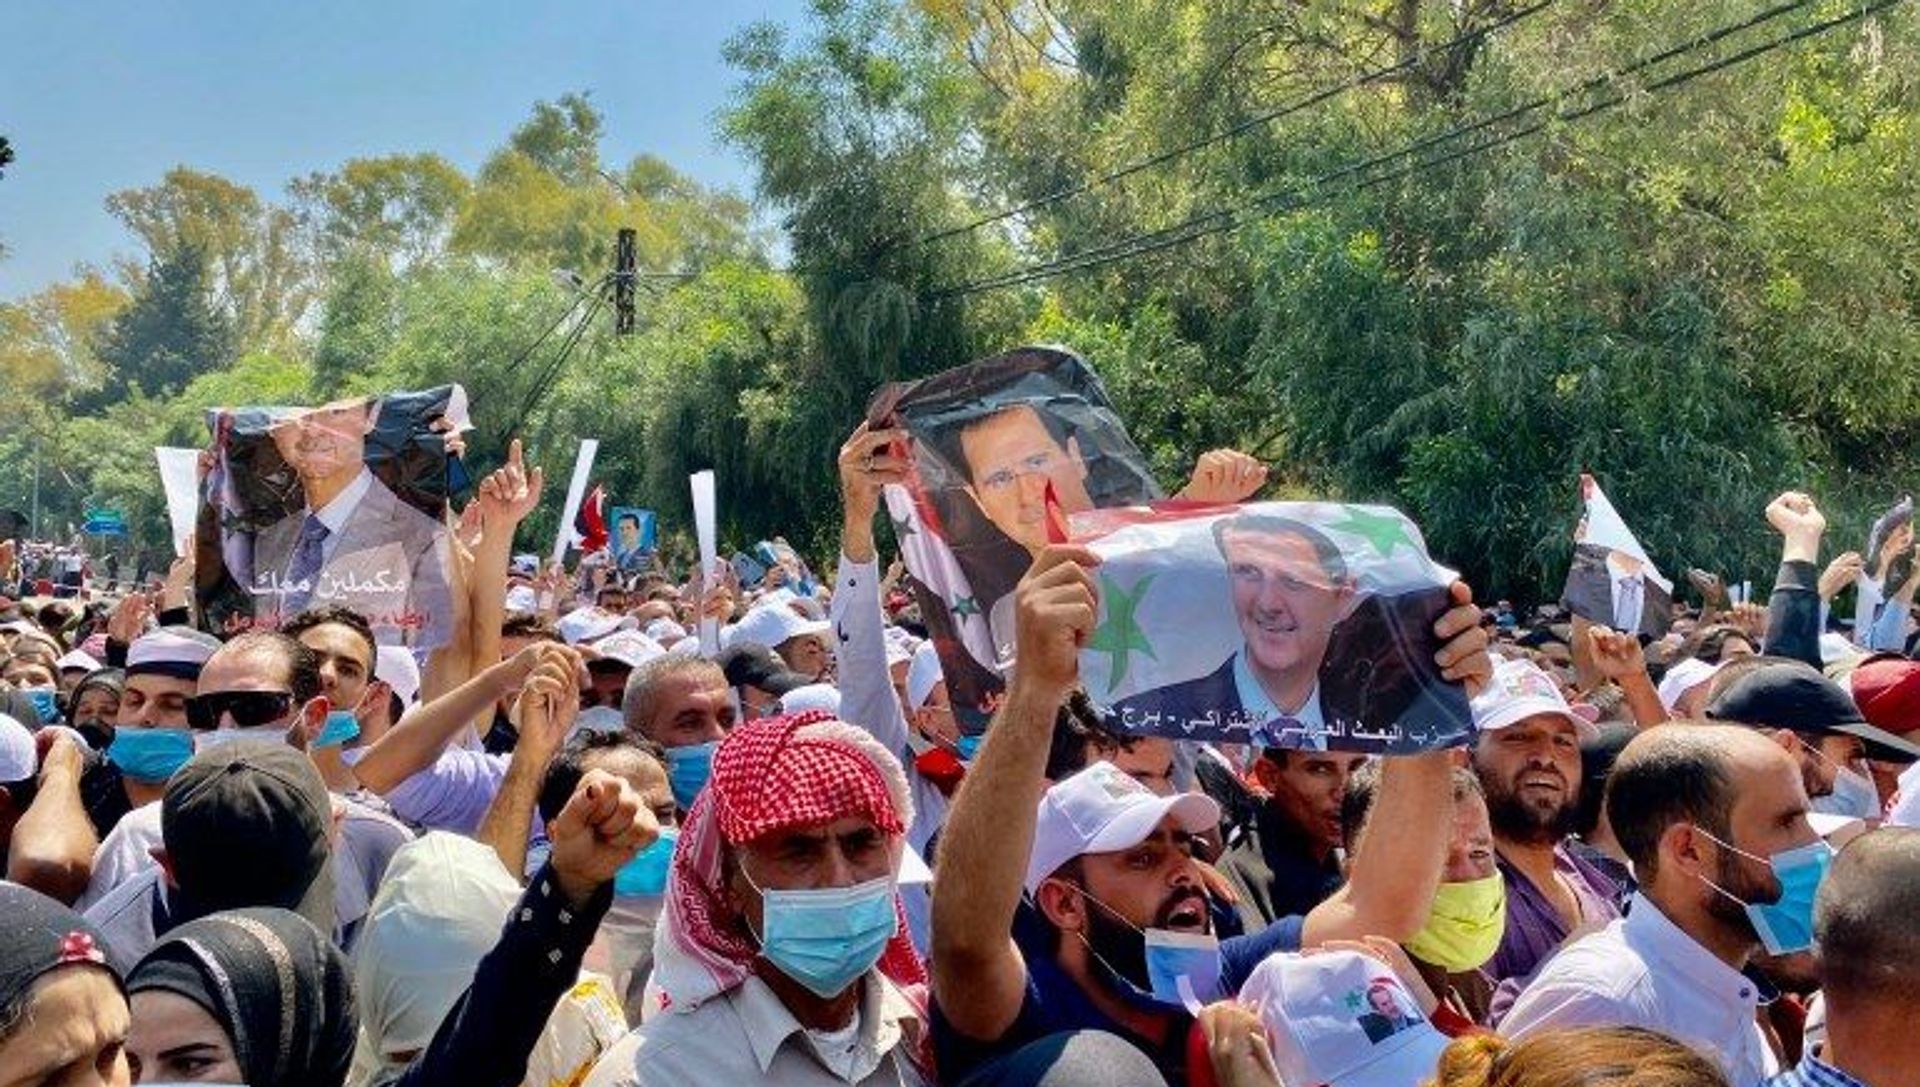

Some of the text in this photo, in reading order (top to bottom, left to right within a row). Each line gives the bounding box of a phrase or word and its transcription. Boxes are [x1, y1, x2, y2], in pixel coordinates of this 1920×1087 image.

[248, 569, 405, 600] مكملين معك
[1121, 706, 1161, 729] برج
[1273, 718, 1345, 741] العربي
[1351, 720, 1403, 745] البعث
